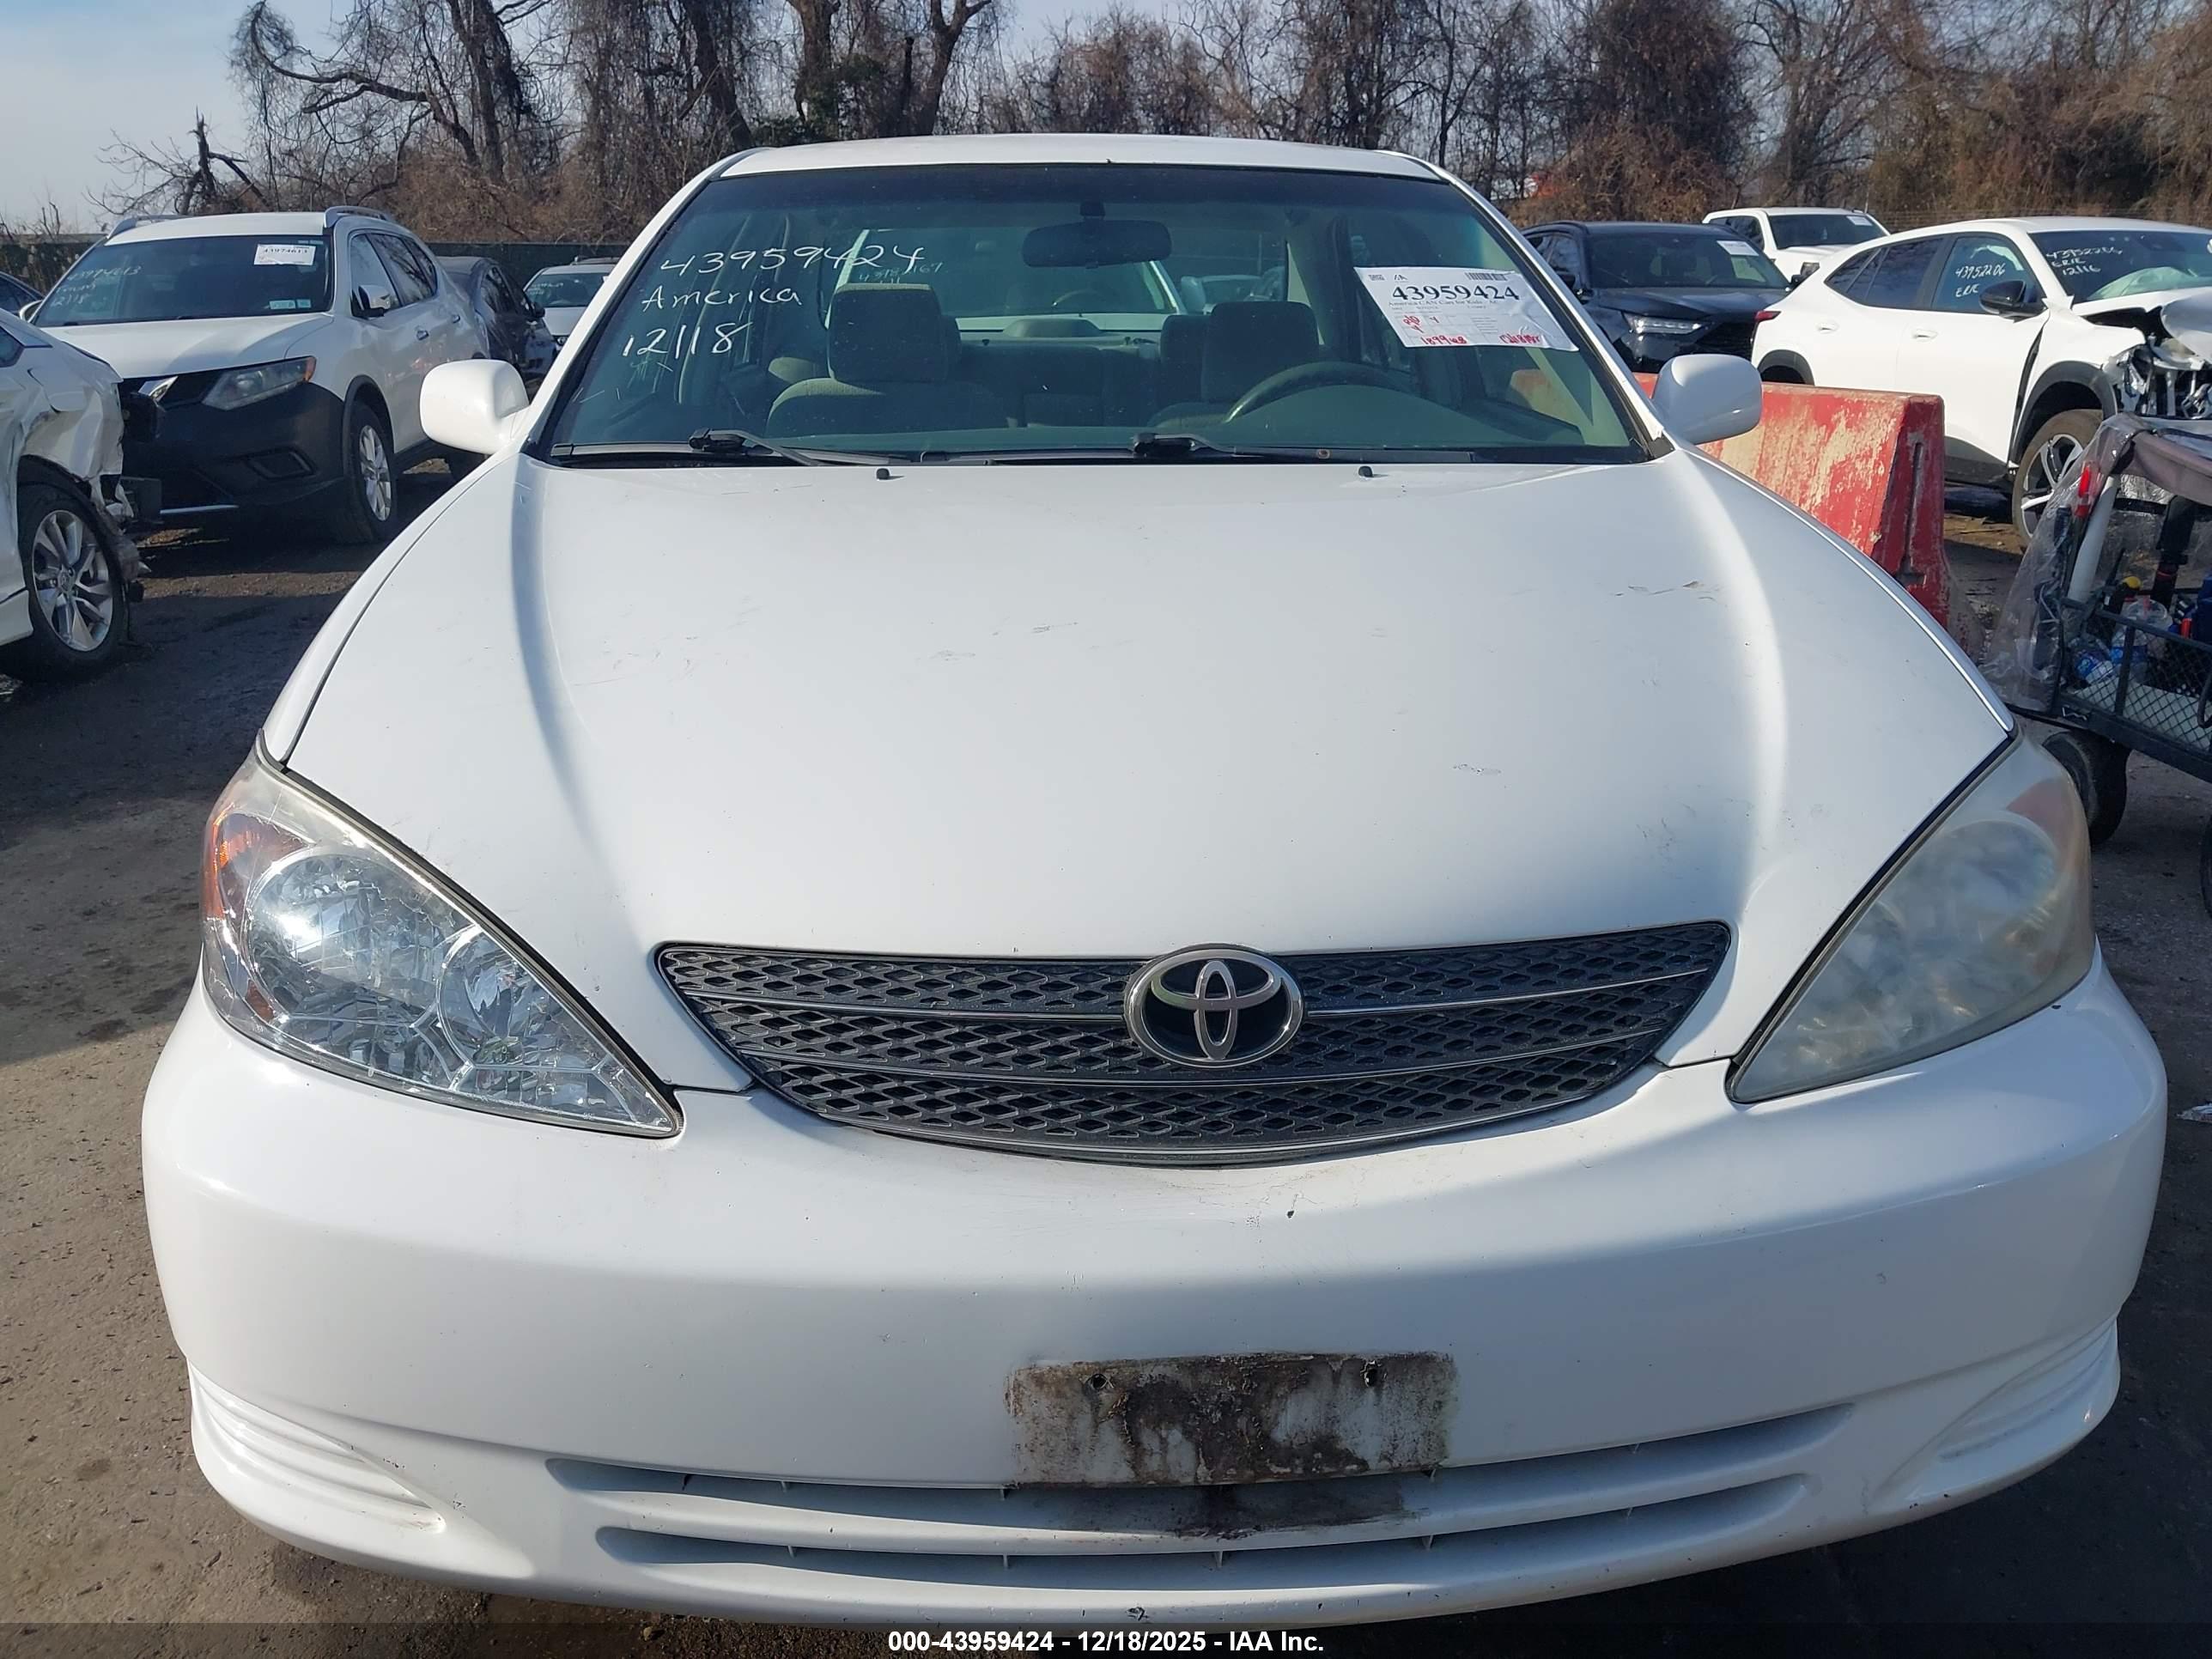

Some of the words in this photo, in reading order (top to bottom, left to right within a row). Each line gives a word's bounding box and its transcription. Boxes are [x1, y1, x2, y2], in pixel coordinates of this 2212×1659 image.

[660, 245, 926, 276] 43959424
[1955, 263, 2006, 279] 43952206
[642, 284, 802, 312] America
[1392, 285, 1520, 301] 43959424
